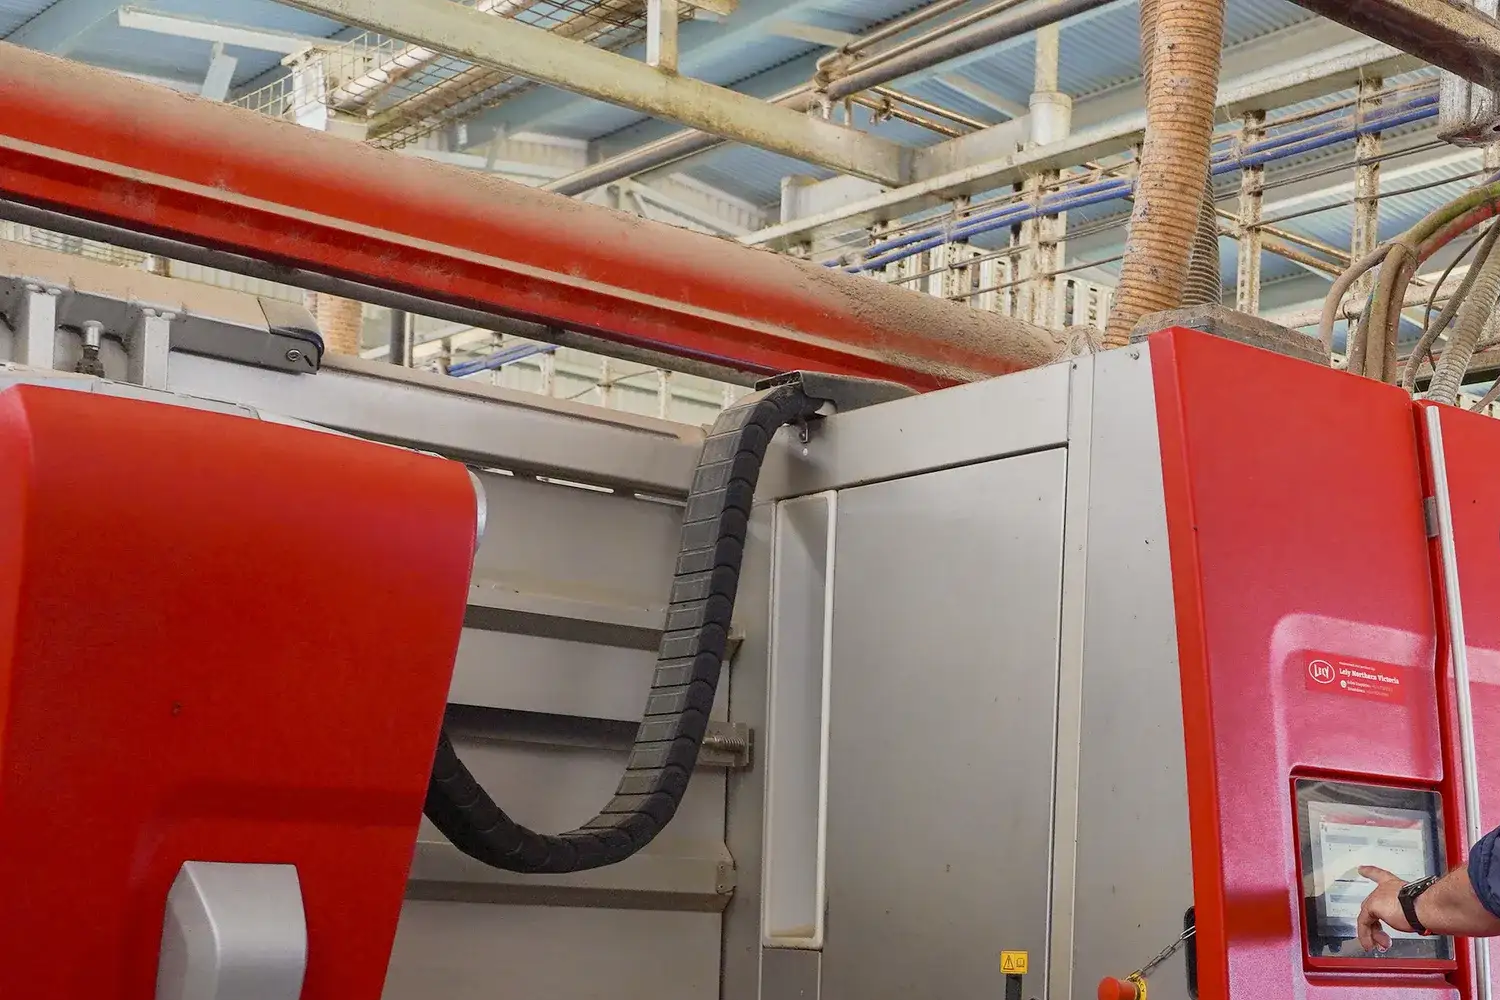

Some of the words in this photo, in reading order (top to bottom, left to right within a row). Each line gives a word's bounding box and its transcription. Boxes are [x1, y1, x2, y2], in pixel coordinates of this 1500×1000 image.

[1339, 667, 1352, 677] Lely
[1352, 669, 1377, 681] Northern
[1377, 672, 1400, 685] Victoria
